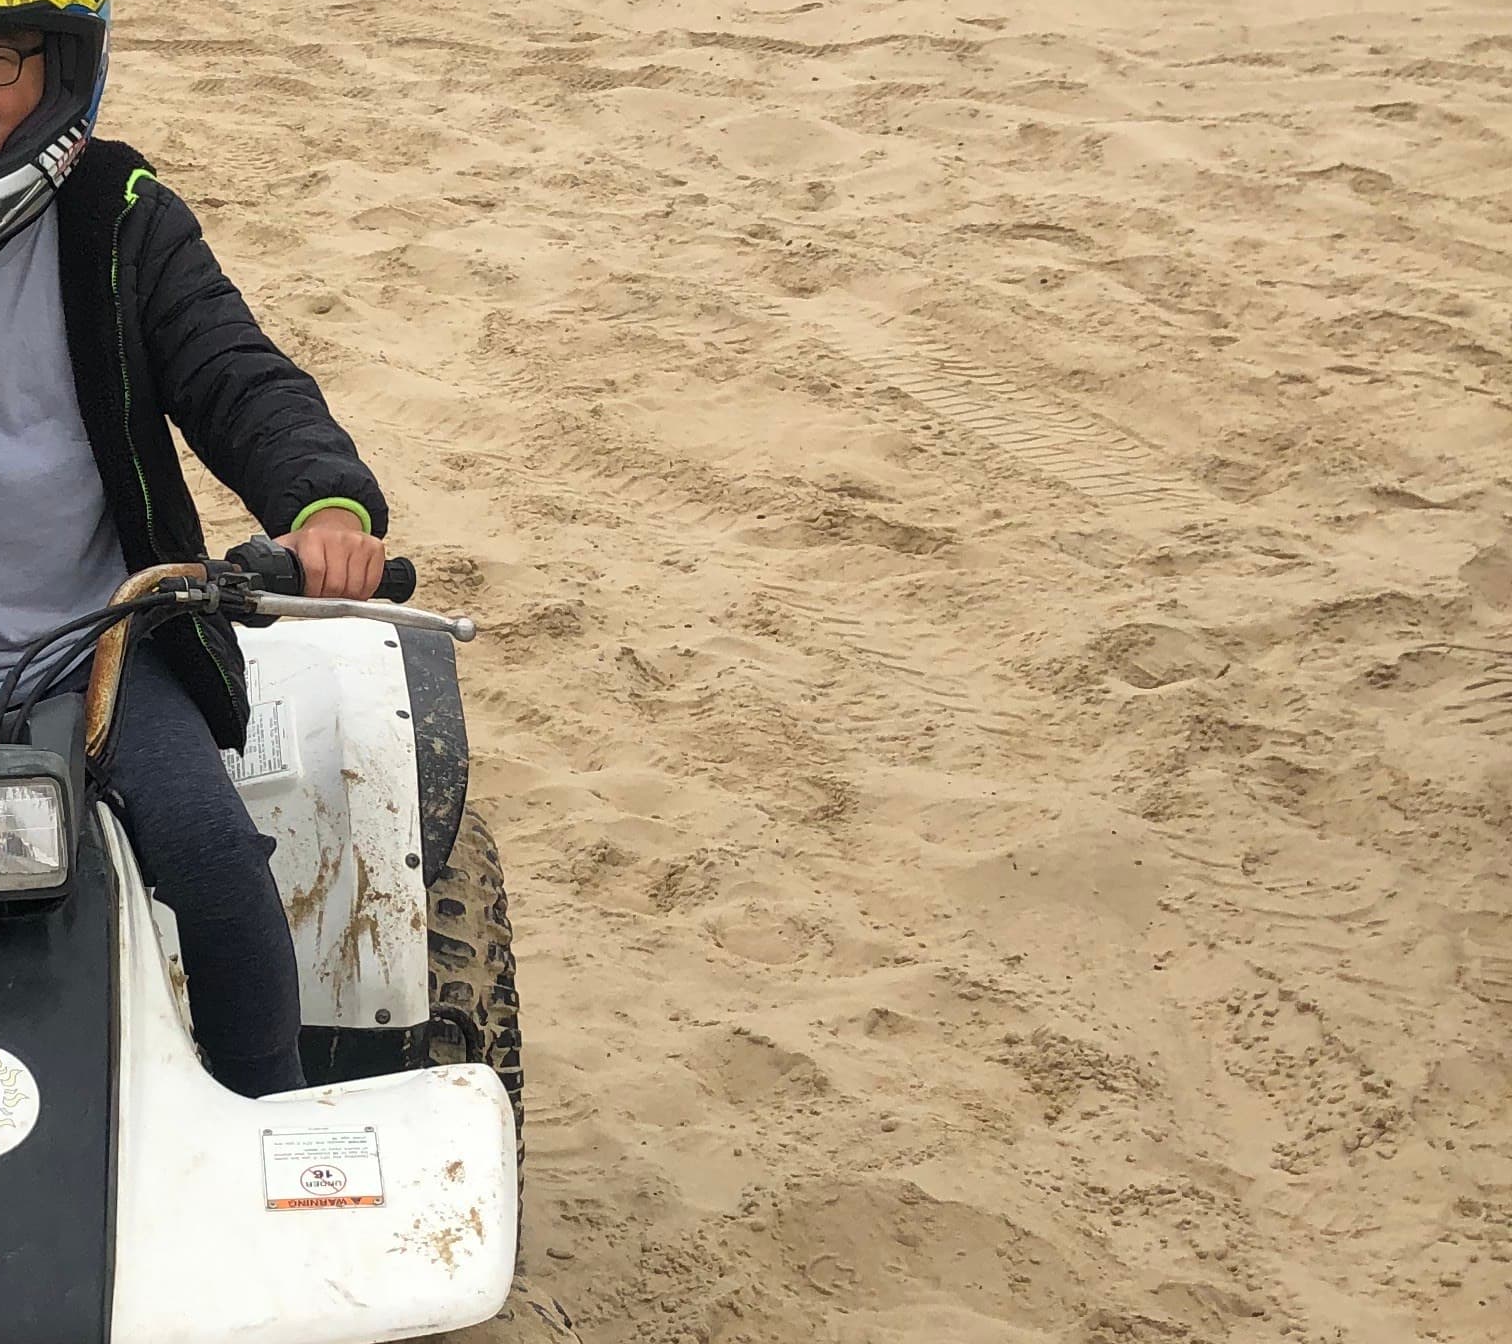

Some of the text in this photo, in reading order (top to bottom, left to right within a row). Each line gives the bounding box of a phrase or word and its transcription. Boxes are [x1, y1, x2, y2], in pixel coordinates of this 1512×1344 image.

[313, 1169, 333, 1179] 16
[305, 1180, 342, 1188] UNDER
[287, 1197, 349, 1208] WARNING
